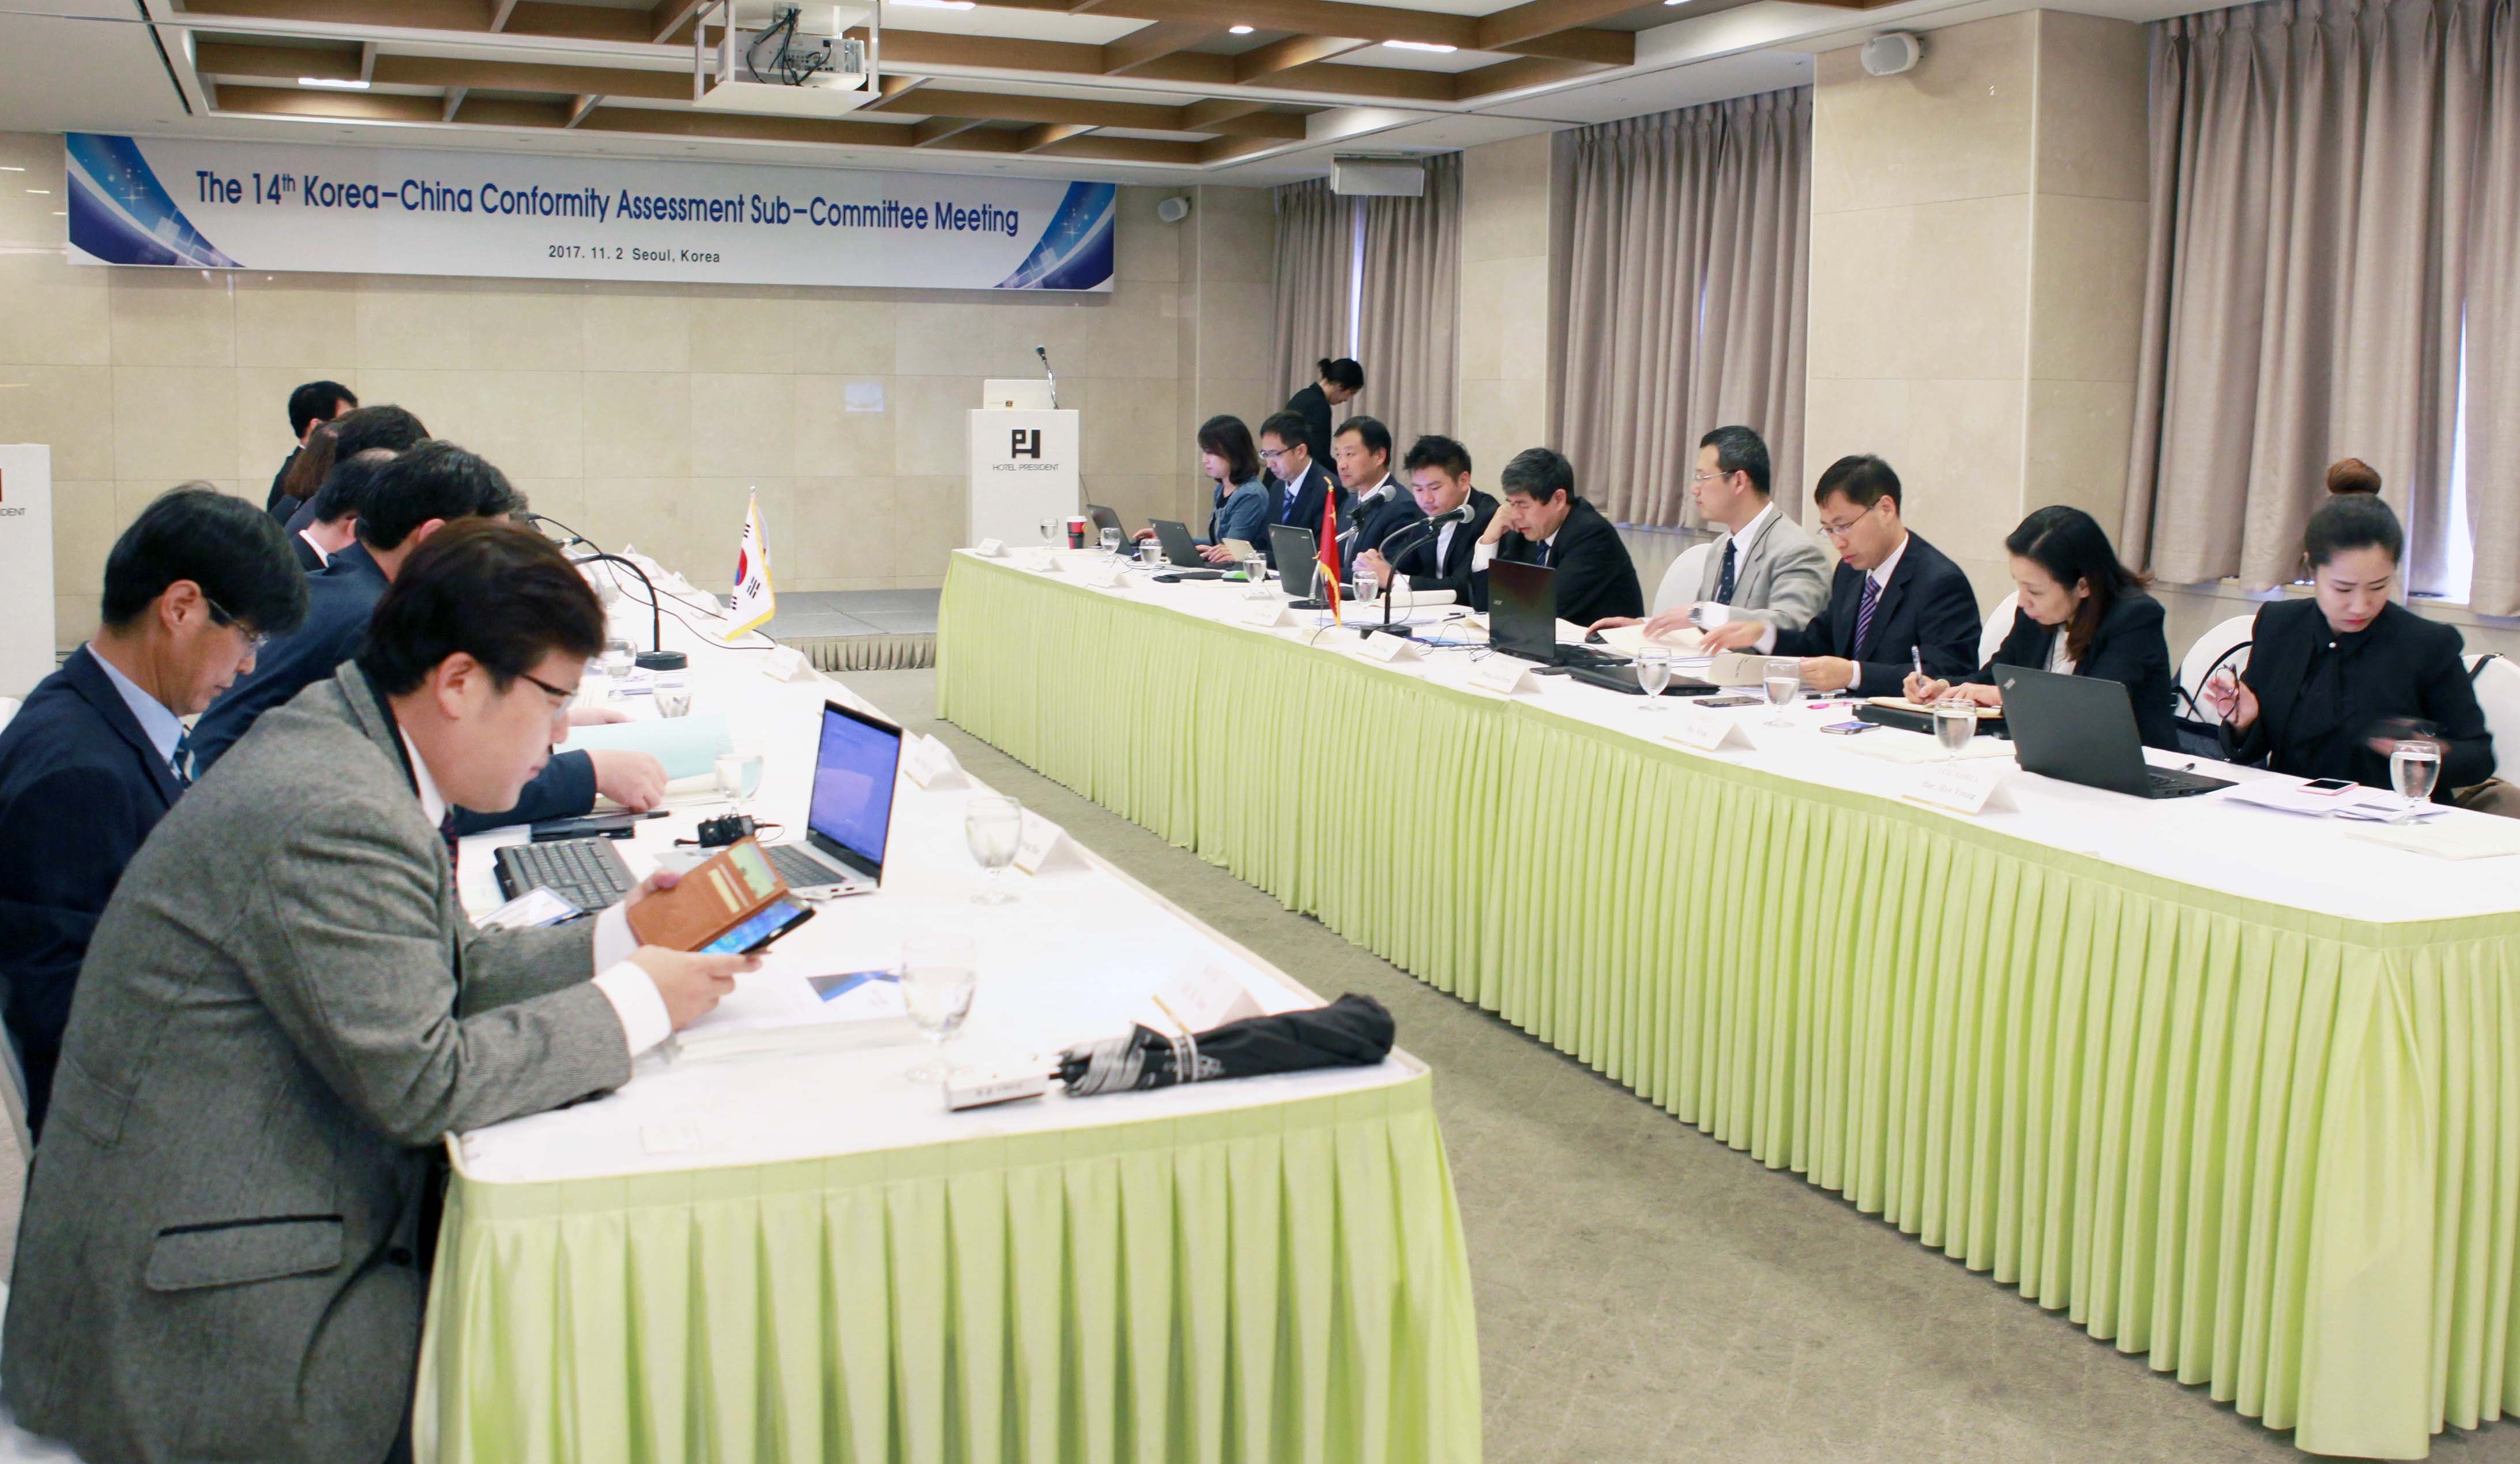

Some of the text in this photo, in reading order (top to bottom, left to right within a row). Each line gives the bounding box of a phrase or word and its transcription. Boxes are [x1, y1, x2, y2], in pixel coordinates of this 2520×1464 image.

[196, 170, 1019, 237] The 14th Korea-China Conformity Assessment Sub-Committee Meeting
[548, 245, 720, 263] 2017. 11. 2 Seoul, Korea
[992, 463, 1059, 471] HOTEL PRESIDENT
